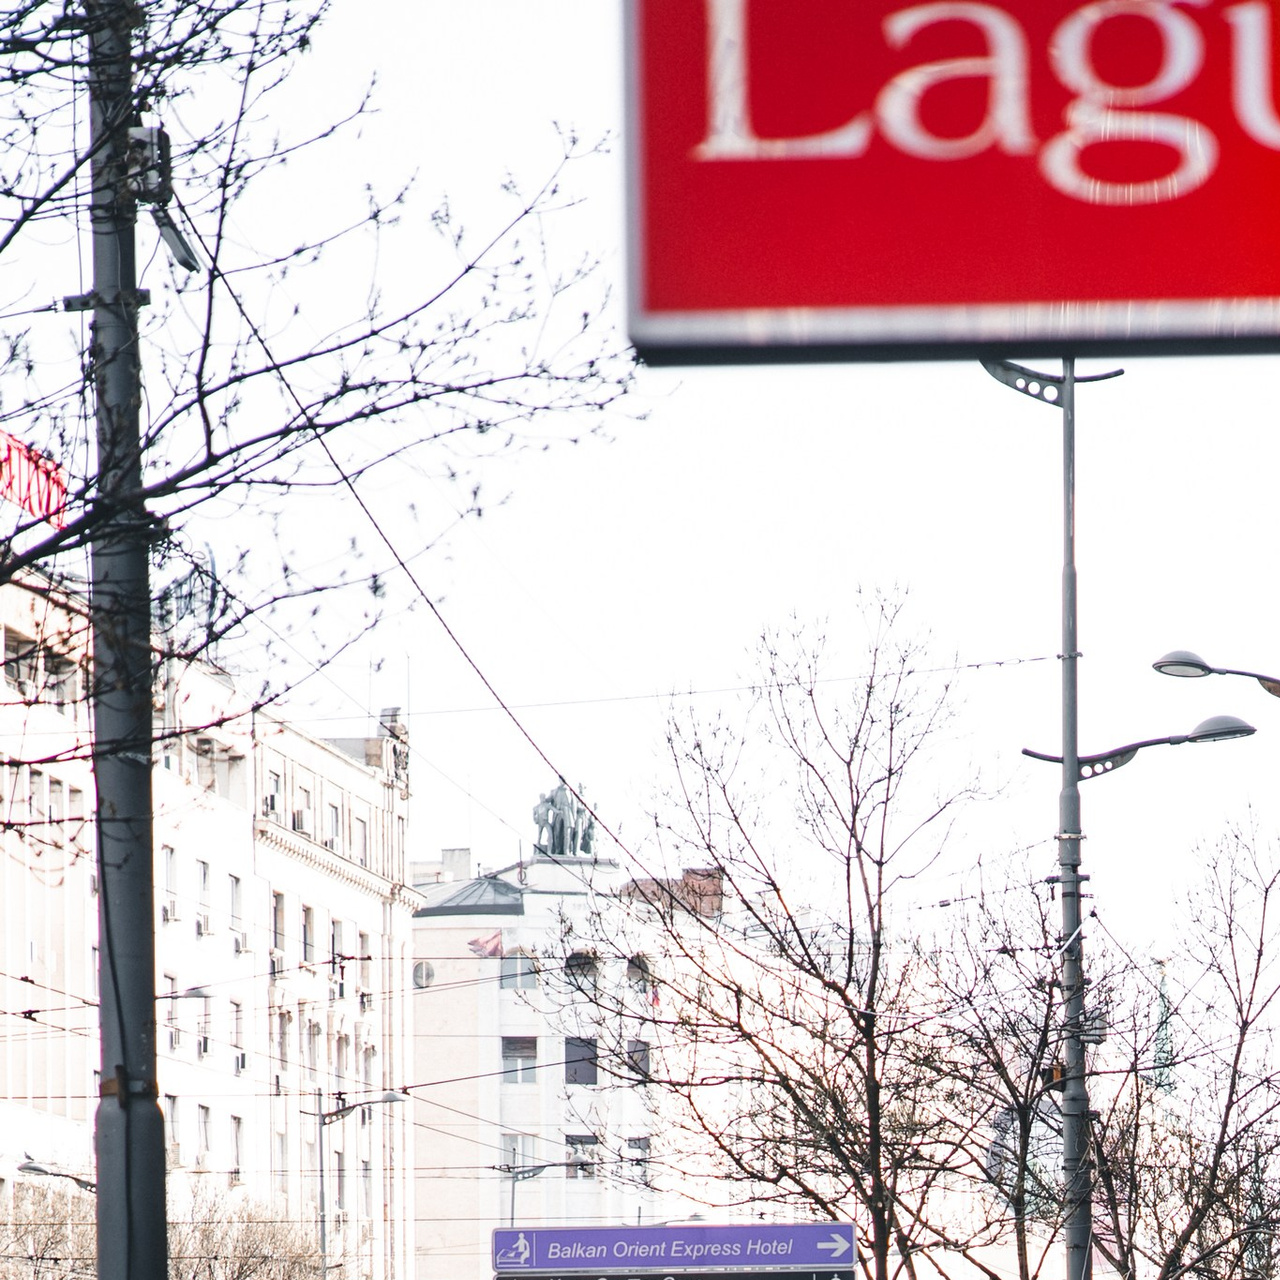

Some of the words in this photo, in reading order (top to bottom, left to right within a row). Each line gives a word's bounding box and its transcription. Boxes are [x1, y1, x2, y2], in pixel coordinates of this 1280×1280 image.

[547, 1242, 607, 1259] Balkan
[613, 1241, 666, 1257] Orient
[670, 1240, 742, 1260] Express
[746, 1238, 793, 1256] Hotel
